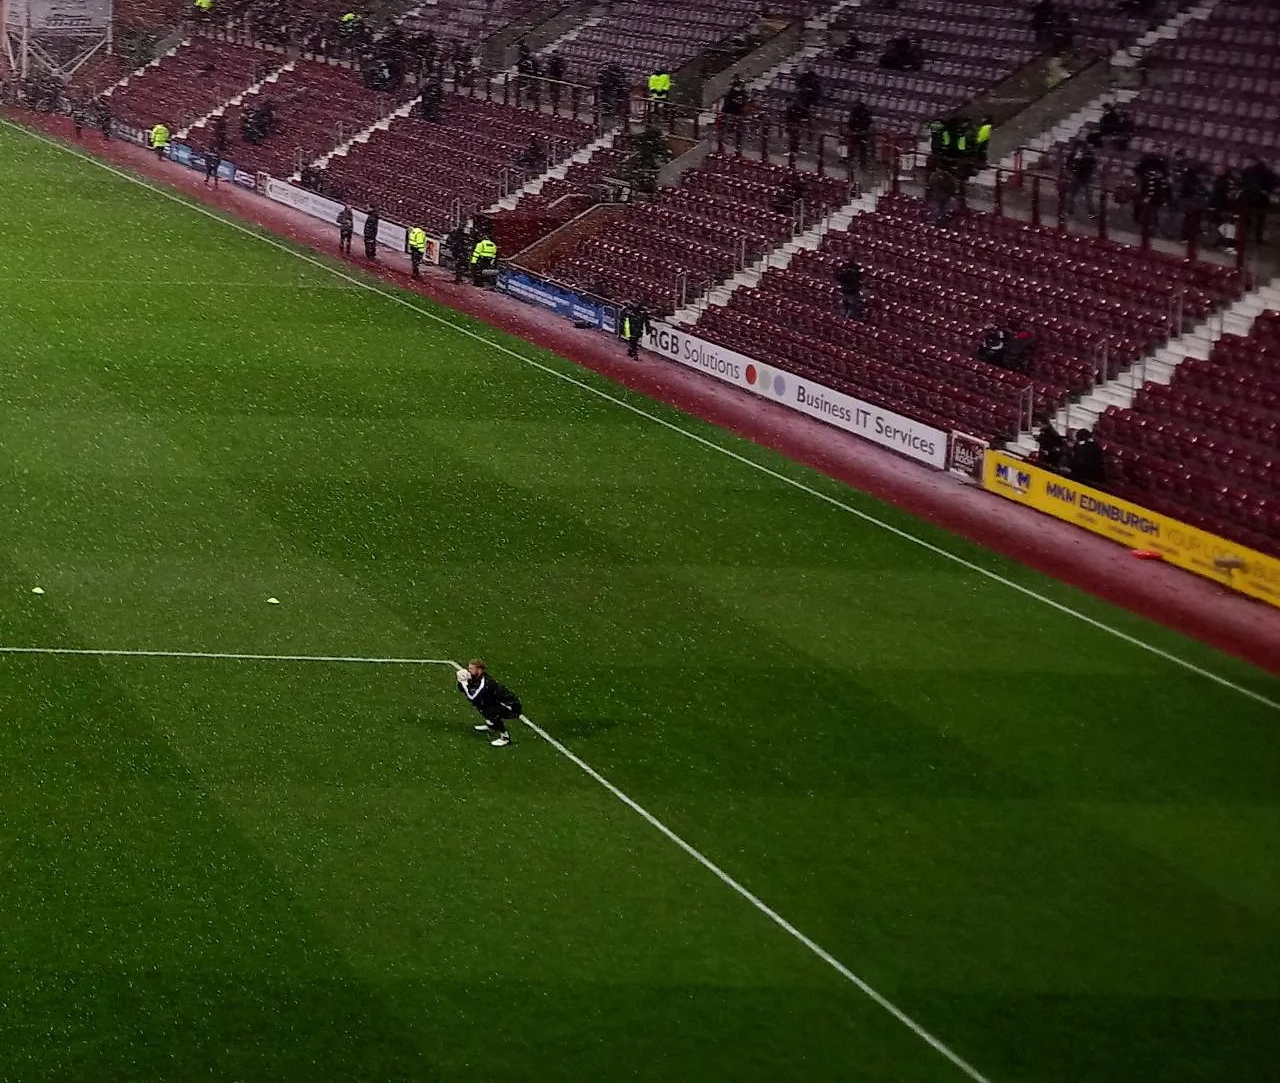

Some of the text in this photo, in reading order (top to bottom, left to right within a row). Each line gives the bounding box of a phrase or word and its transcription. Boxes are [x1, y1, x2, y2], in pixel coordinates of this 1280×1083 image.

[649, 327, 740, 379] RGB Solutions
[796, 385, 936, 455] Business IT Services
[1046, 481, 1076, 505] MKM
[1080, 493, 1160, 537] EDINBURGH
